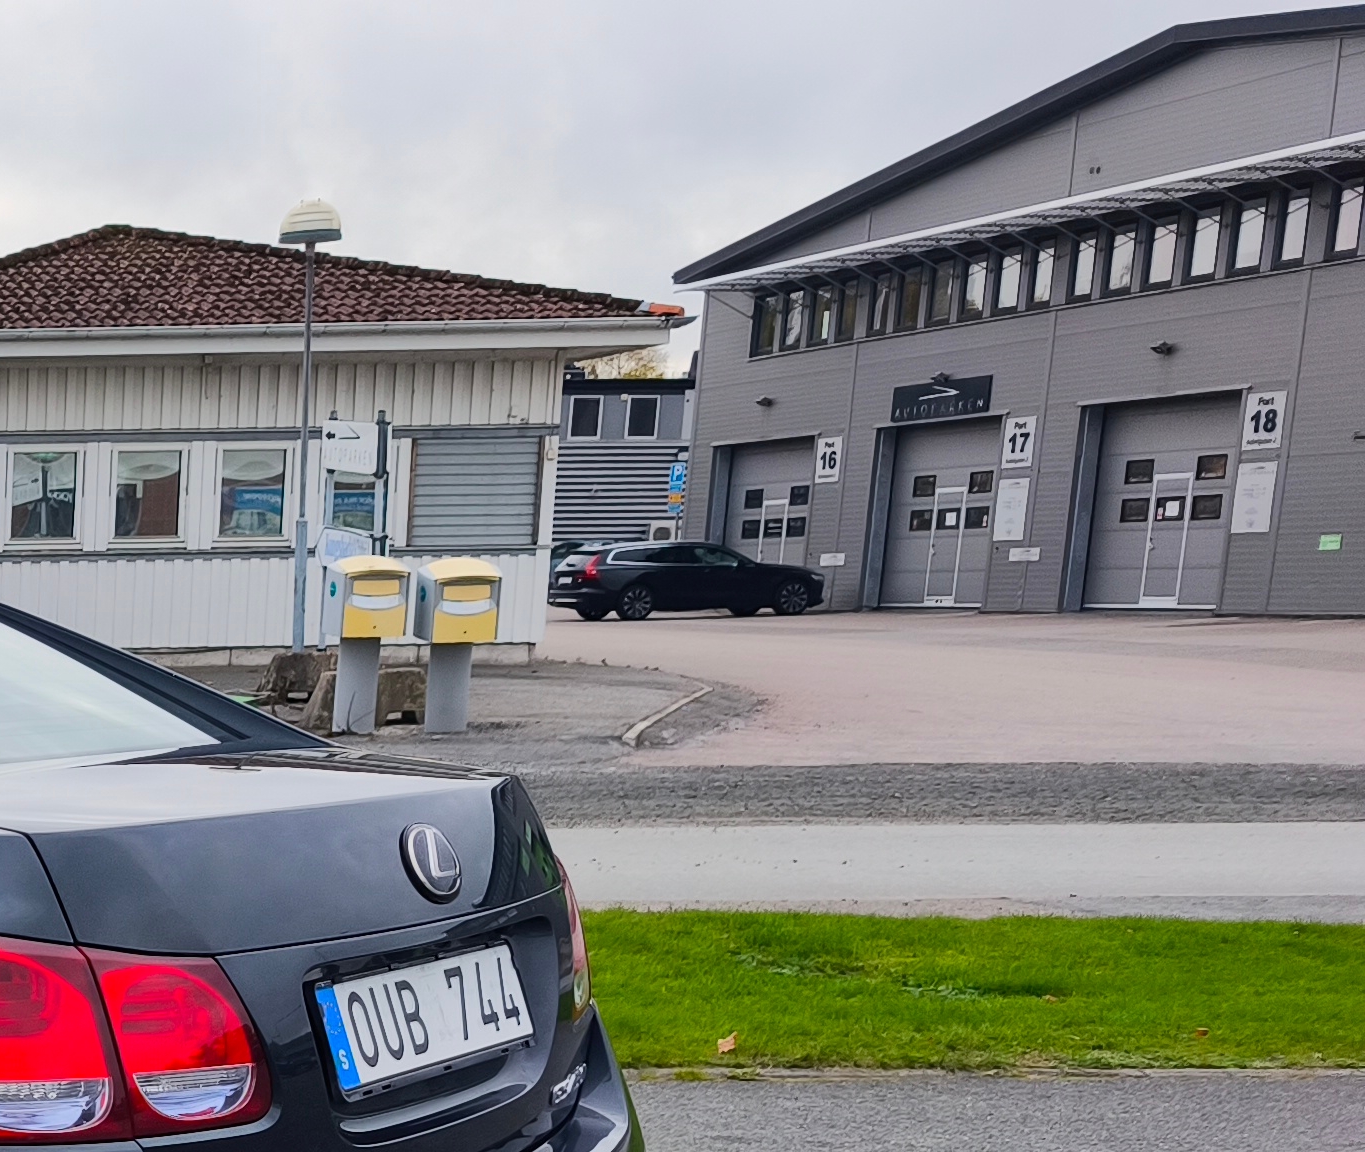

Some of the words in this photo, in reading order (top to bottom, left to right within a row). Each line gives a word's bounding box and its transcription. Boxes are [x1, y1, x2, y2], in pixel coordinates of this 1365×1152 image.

[1250, 408, 1278, 434] 18
[1008, 432, 1031, 454] 17
[820, 450, 837, 470] 16
[347, 979, 429, 1067] OUB
[444, 957, 521, 1041] 744
[338, 1049, 350, 1070] S
